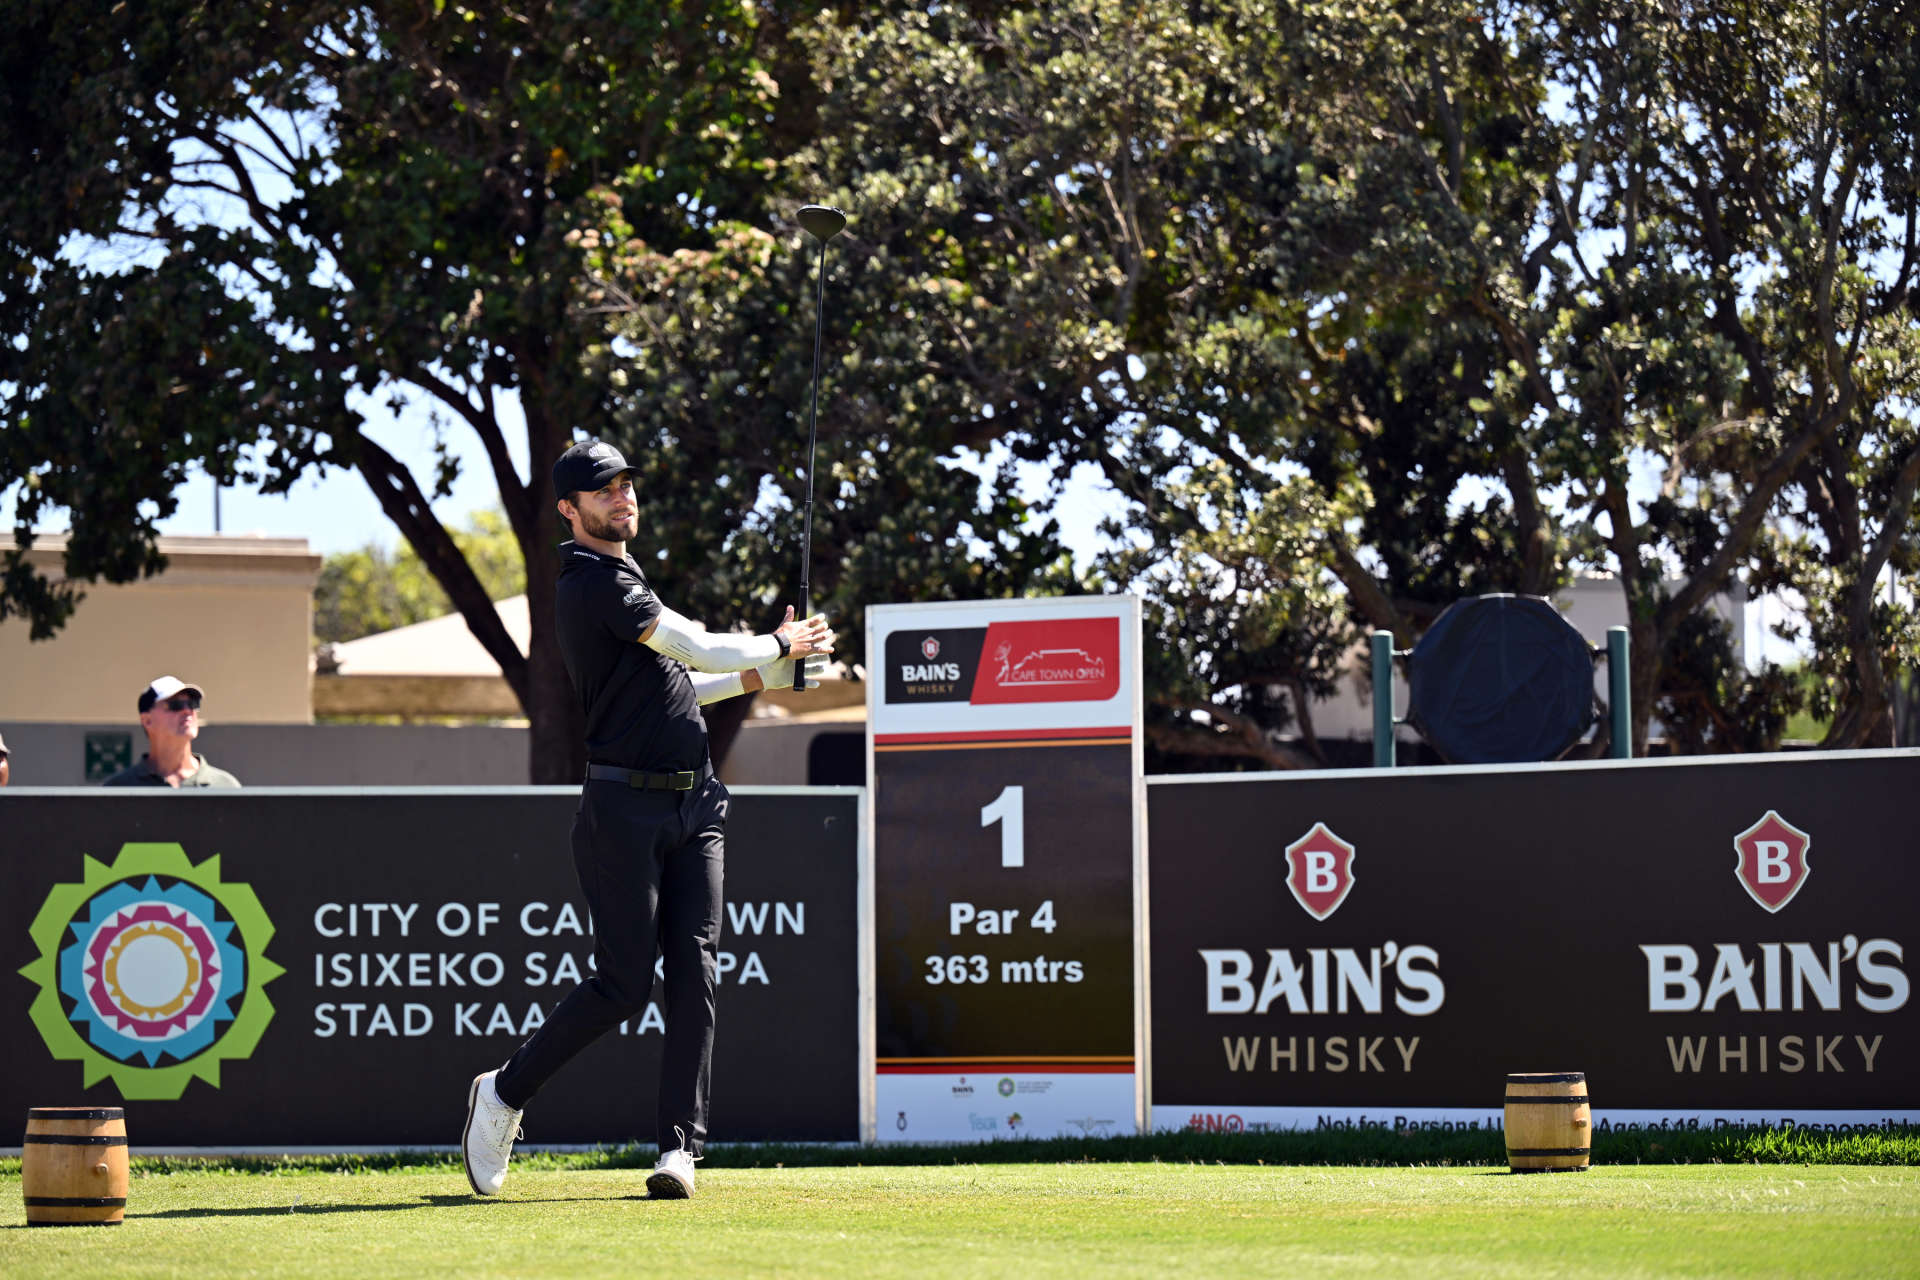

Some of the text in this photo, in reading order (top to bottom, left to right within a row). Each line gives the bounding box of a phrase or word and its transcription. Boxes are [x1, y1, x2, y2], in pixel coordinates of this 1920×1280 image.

[902, 662, 961, 682] BAIN'S
[906, 684, 955, 695] WHISKY
[1011, 667, 1105, 681] CAPE TOWN OPEN
[981, 785, 1024, 868] 1
[1304, 851, 1338, 893] B
[1753, 840, 1792, 884] B
[314, 902, 806, 938] CITY OF CA WN
[950, 900, 1057, 936] Par 4
[315, 952, 505, 988] ISIXEKO
[924, 954, 1085, 985] 363 mtrs
[1198, 940, 1446, 1017] BAIN'S
[1638, 934, 1911, 1013] BAIN'S
[314, 1002, 433, 1038] STAD
[1222, 1036, 1421, 1073] WHISKY
[1666, 1035, 1884, 1073] WHISKY
[1359, 1115, 1388, 1131] for
